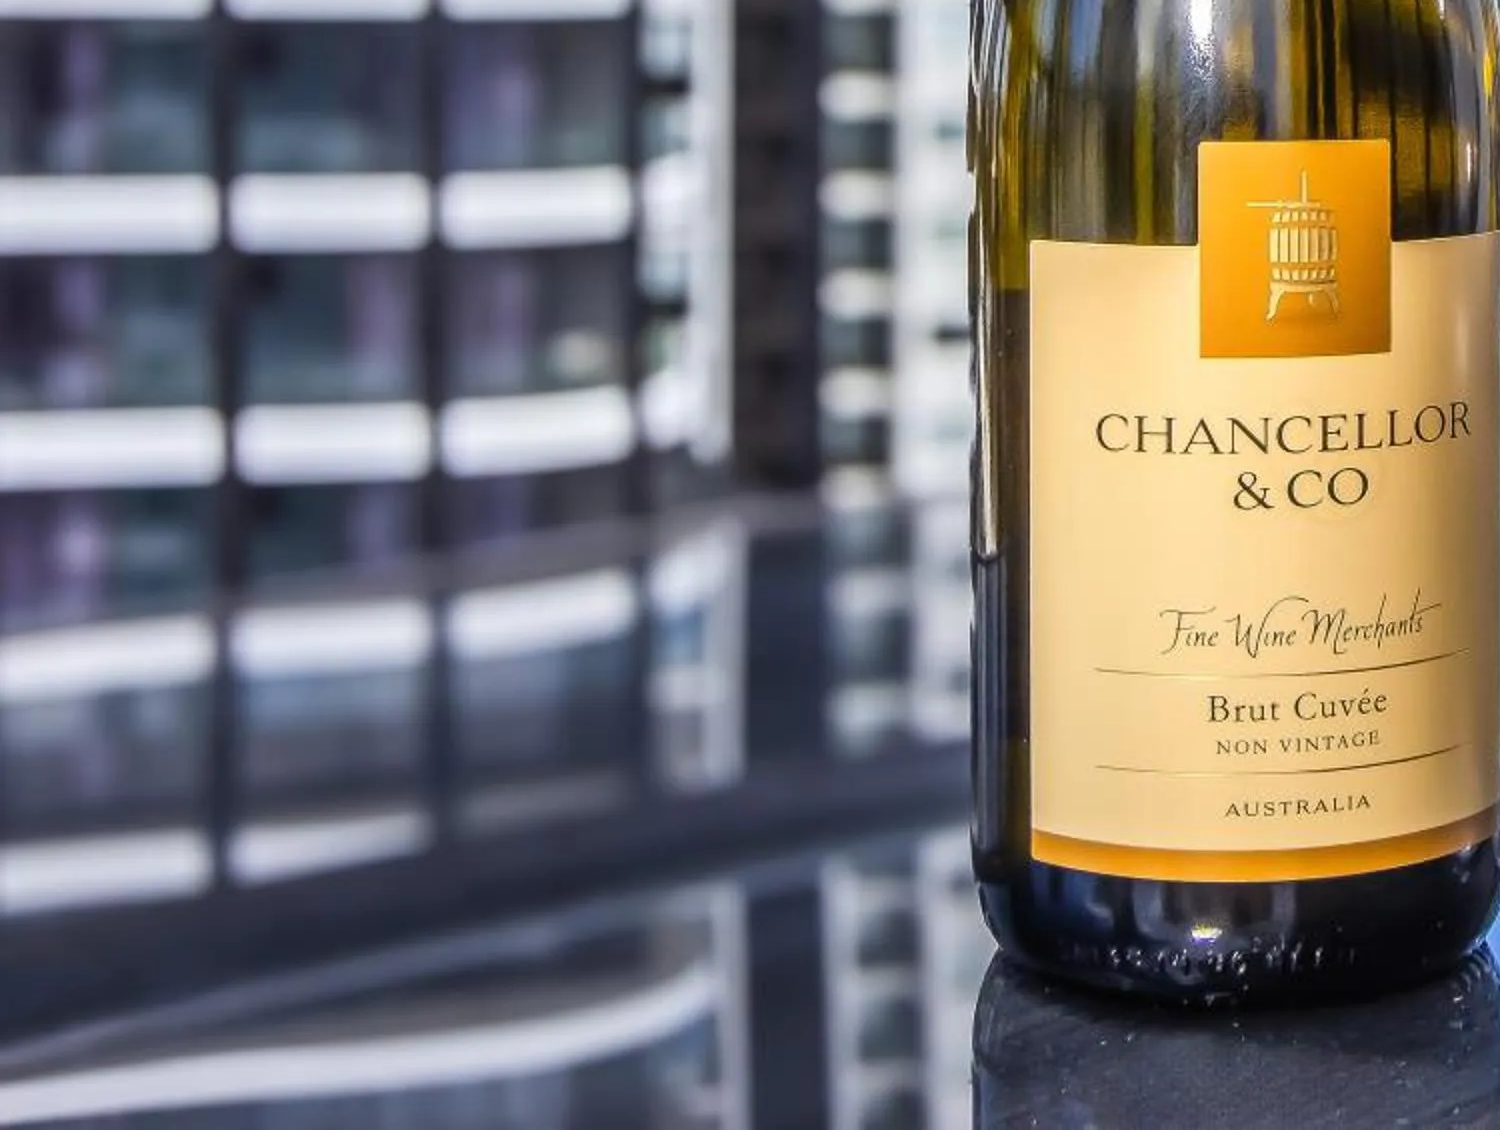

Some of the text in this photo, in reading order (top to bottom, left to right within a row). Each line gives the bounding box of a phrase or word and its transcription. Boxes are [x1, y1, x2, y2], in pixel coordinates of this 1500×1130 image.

[1095, 401, 1472, 455] CHANCELLOR
[1233, 467, 1369, 510] & CO
[1159, 587, 1442, 658] Fine Wine Merchants
[1207, 688, 1388, 724] Brut Cuvée
[1215, 730, 1380, 755] NON VINTAGE
[1225, 794, 1371, 818] AUSTRALIA
